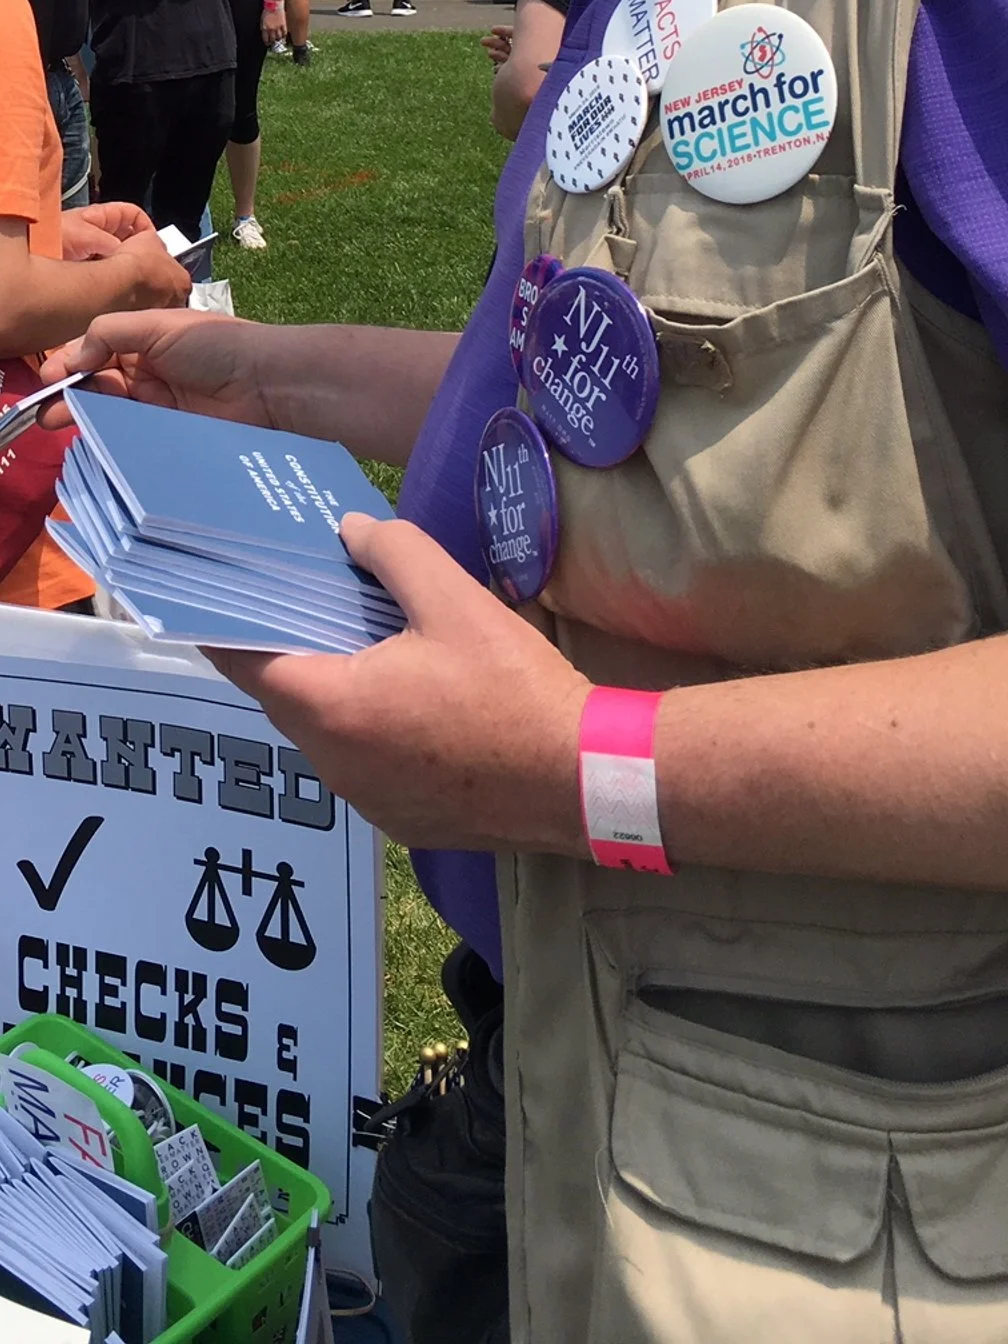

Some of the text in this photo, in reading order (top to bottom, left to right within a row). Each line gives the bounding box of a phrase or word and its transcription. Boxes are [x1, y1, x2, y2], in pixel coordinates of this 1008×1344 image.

[568, 92, 603, 133] MARCH
[571, 95, 612, 142] FOR OUR
[664, 78, 744, 115] NEW JERSEY
[667, 82, 771, 140] march
[773, 69, 824, 104] for
[574, 118, 602, 151] LIVES
[672, 96, 830, 171] SCIENCE
[519, 278, 538, 305] BRO
[533, 356, 594, 435] change
[562, 354, 606, 411] for
[239, 455, 280, 511] OF AMERICA
[252, 451, 305, 523] UNITED STATES
[285, 454, 339, 534] CONSTITUTION
[322, 490, 339, 506] THE
[500, 496, 526, 535] for
[489, 535, 532, 563] change
[17, 933, 250, 1063] CHECKS
